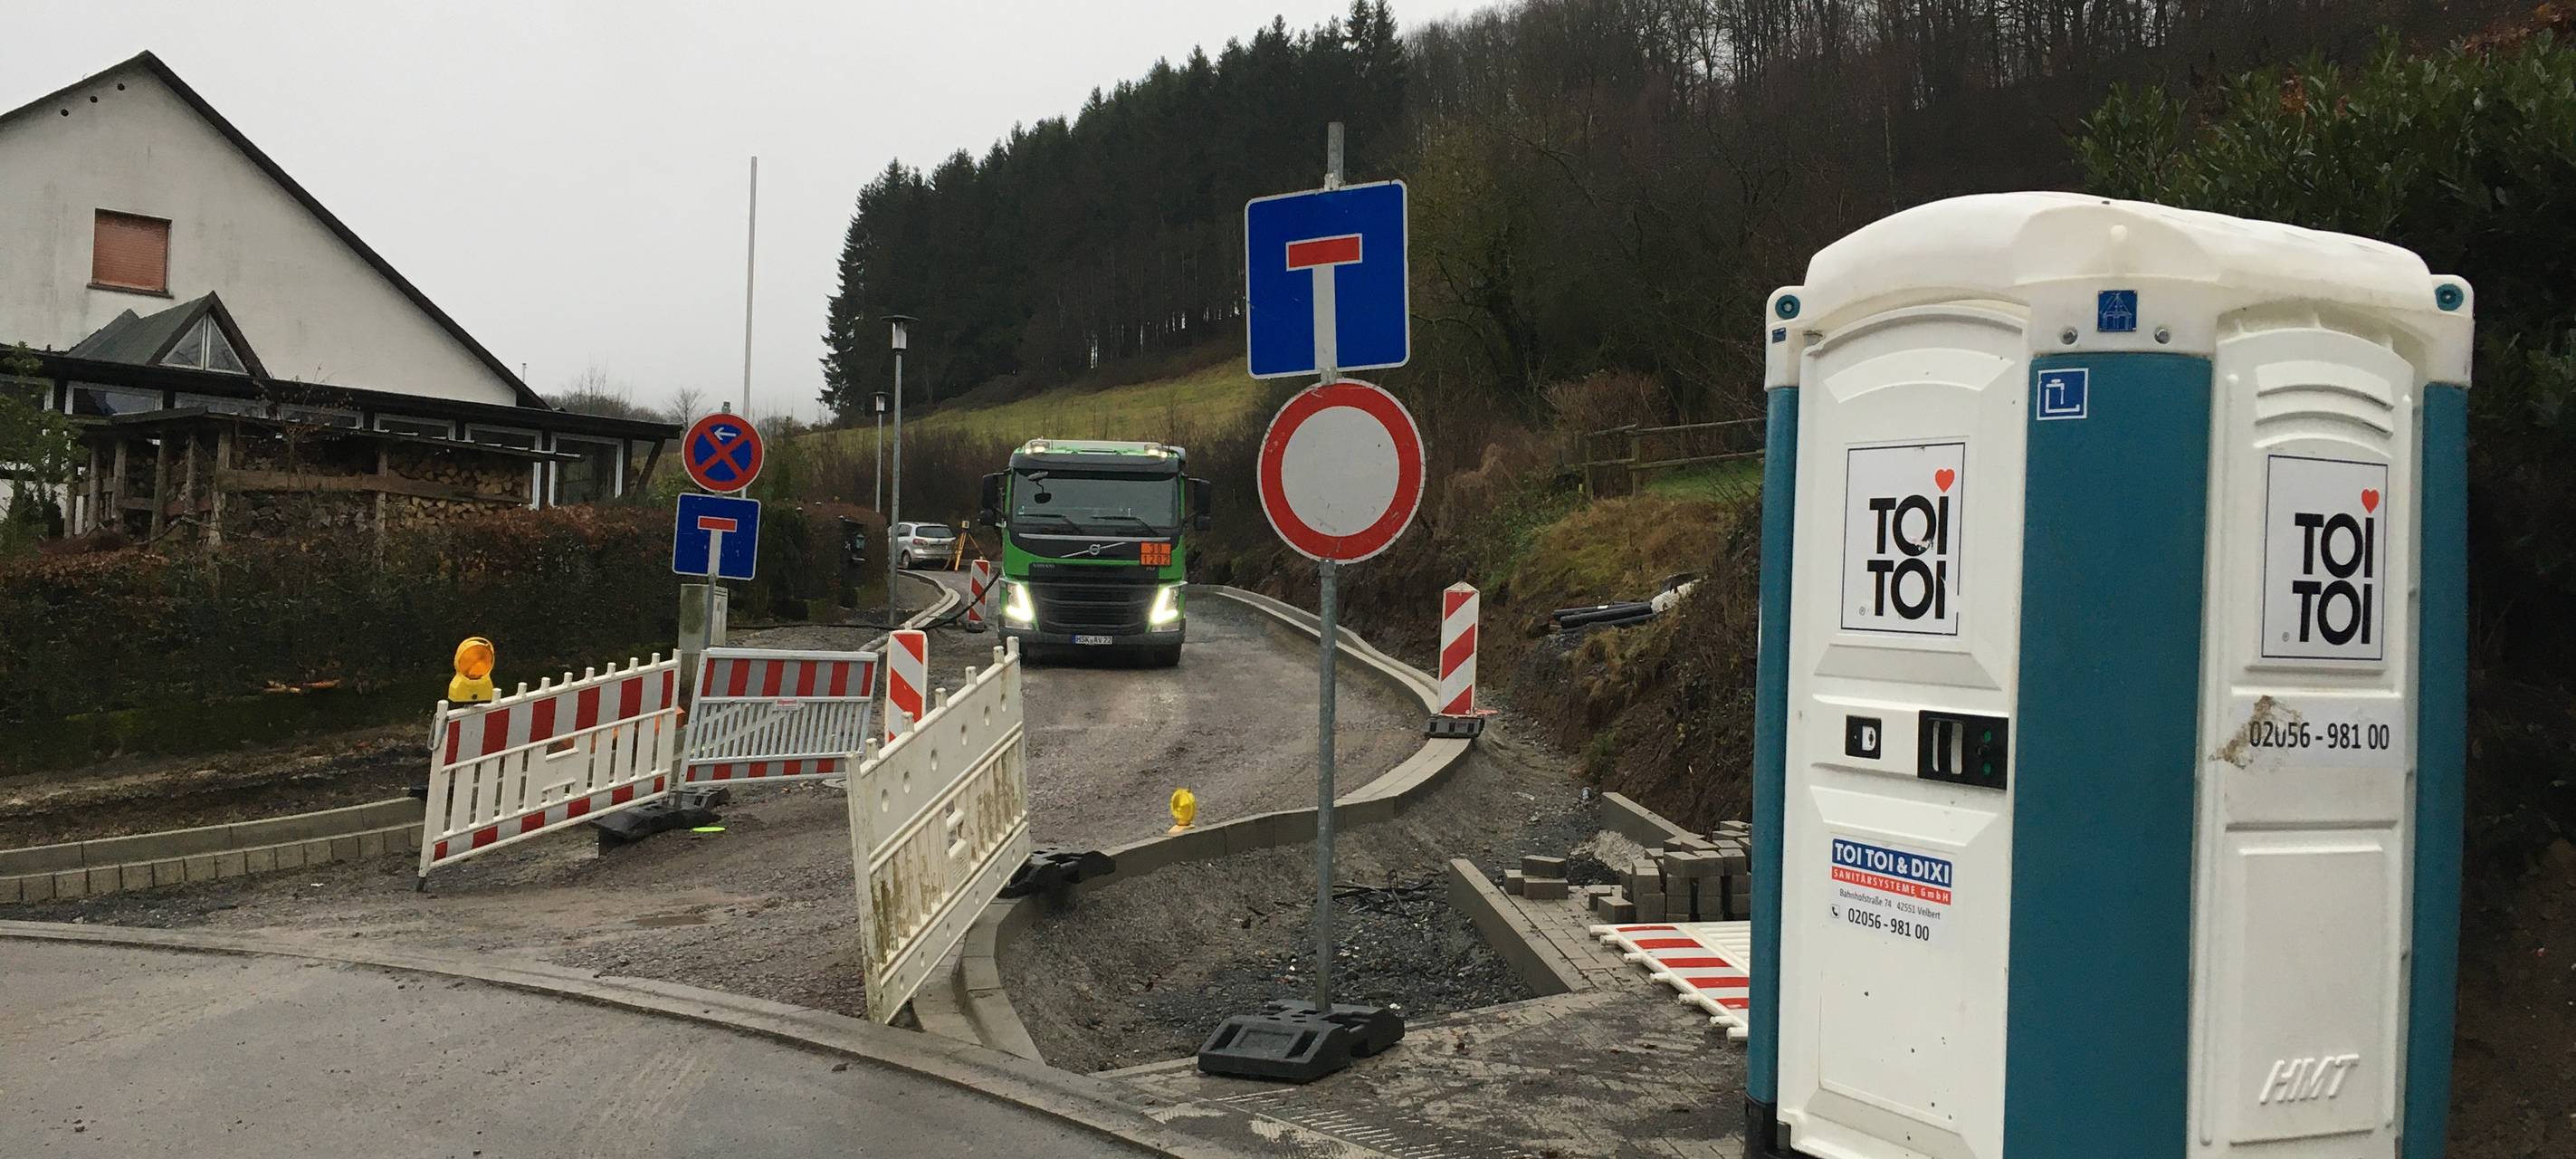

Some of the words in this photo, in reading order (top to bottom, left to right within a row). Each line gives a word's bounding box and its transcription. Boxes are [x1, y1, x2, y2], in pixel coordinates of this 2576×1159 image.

[1869, 494, 1949, 557] TOI
[2295, 512, 2374, 579] TOI
[1866, 558, 1947, 619] TOI
[2292, 580, 2372, 646] TOI
[2249, 721, 2311, 748] 02056
[2327, 723, 2361, 749] 981
[2368, 723, 2390, 750] 00
[1835, 842, 1862, 865] TOI
[1865, 848, 1894, 871] TOI
[1896, 857, 1908, 874] &
[1911, 858, 1950, 884] DIXI
[1920, 889, 1950, 902] GmbH
[1847, 907, 1882, 929] 02056
[1890, 918, 1912, 937] 981
[1914, 924, 1930, 941] 00
[2259, 1054, 2360, 1106] HMT
